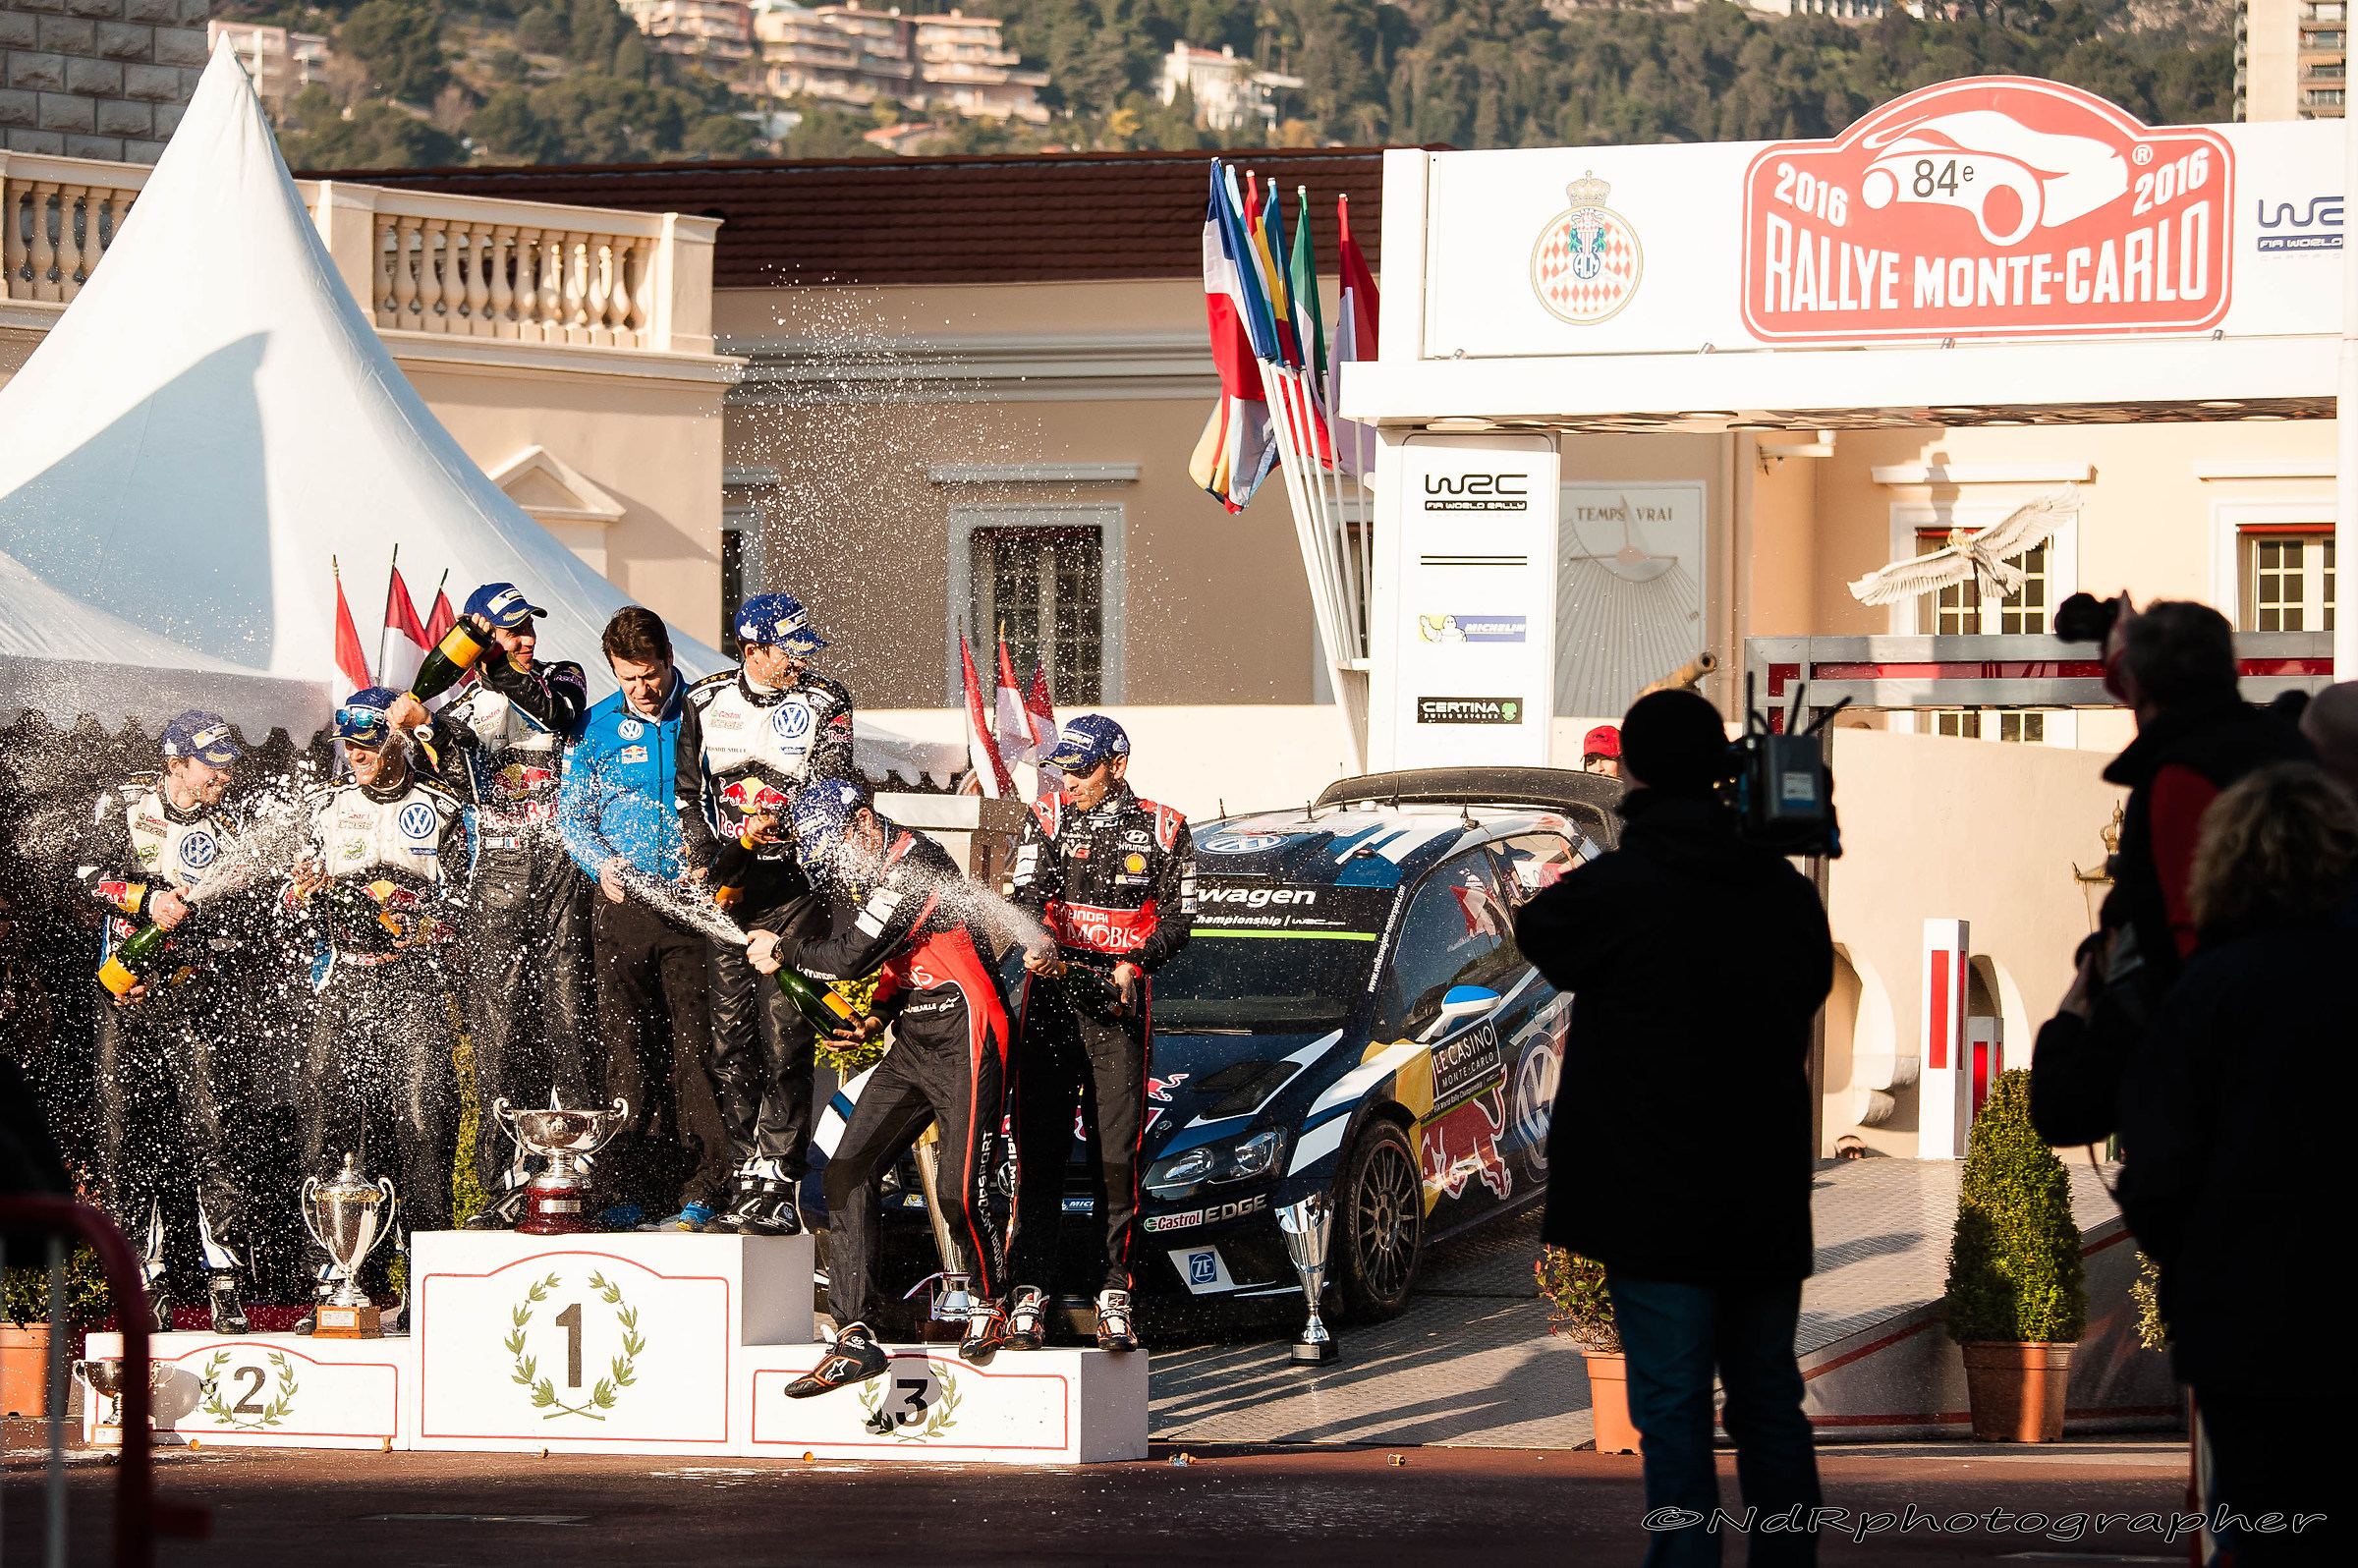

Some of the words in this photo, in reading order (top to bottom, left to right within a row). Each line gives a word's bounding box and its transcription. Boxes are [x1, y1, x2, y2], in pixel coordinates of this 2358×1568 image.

[1773, 161, 1848, 228] 2016
[2132, 147, 2210, 217] 2016
[2258, 196, 2344, 229] WR
[1764, 211, 1900, 313] RALLYE
[1913, 199, 2210, 308] MONTE-CARLO
[2260, 240, 2284, 249] FIA
[2286, 237, 2343, 248] WORLD
[1425, 474, 1528, 495] WRC
[1577, 507, 1626, 522] TEMPS
[1636, 507, 1673, 522] VRAI
[1422, 701, 1500, 713] CERTINA
[1196, 887, 1317, 909] wagen
[1066, 923, 1141, 949] MOBIS
[1367, 884, 1407, 993] www.volkswagen-motorsport.com
[1432, 1050, 1449, 1075] LE
[1447, 1025, 1494, 1066] CASINO
[1157, 1213, 1202, 1230] Castrol
[1204, 1193, 1267, 1224] EDGE
[1191, 1257, 1216, 1280] ZF
[555, 1303, 582, 1388] 1
[233, 1366, 266, 1414] 2
[895, 1378, 928, 1428] 3
